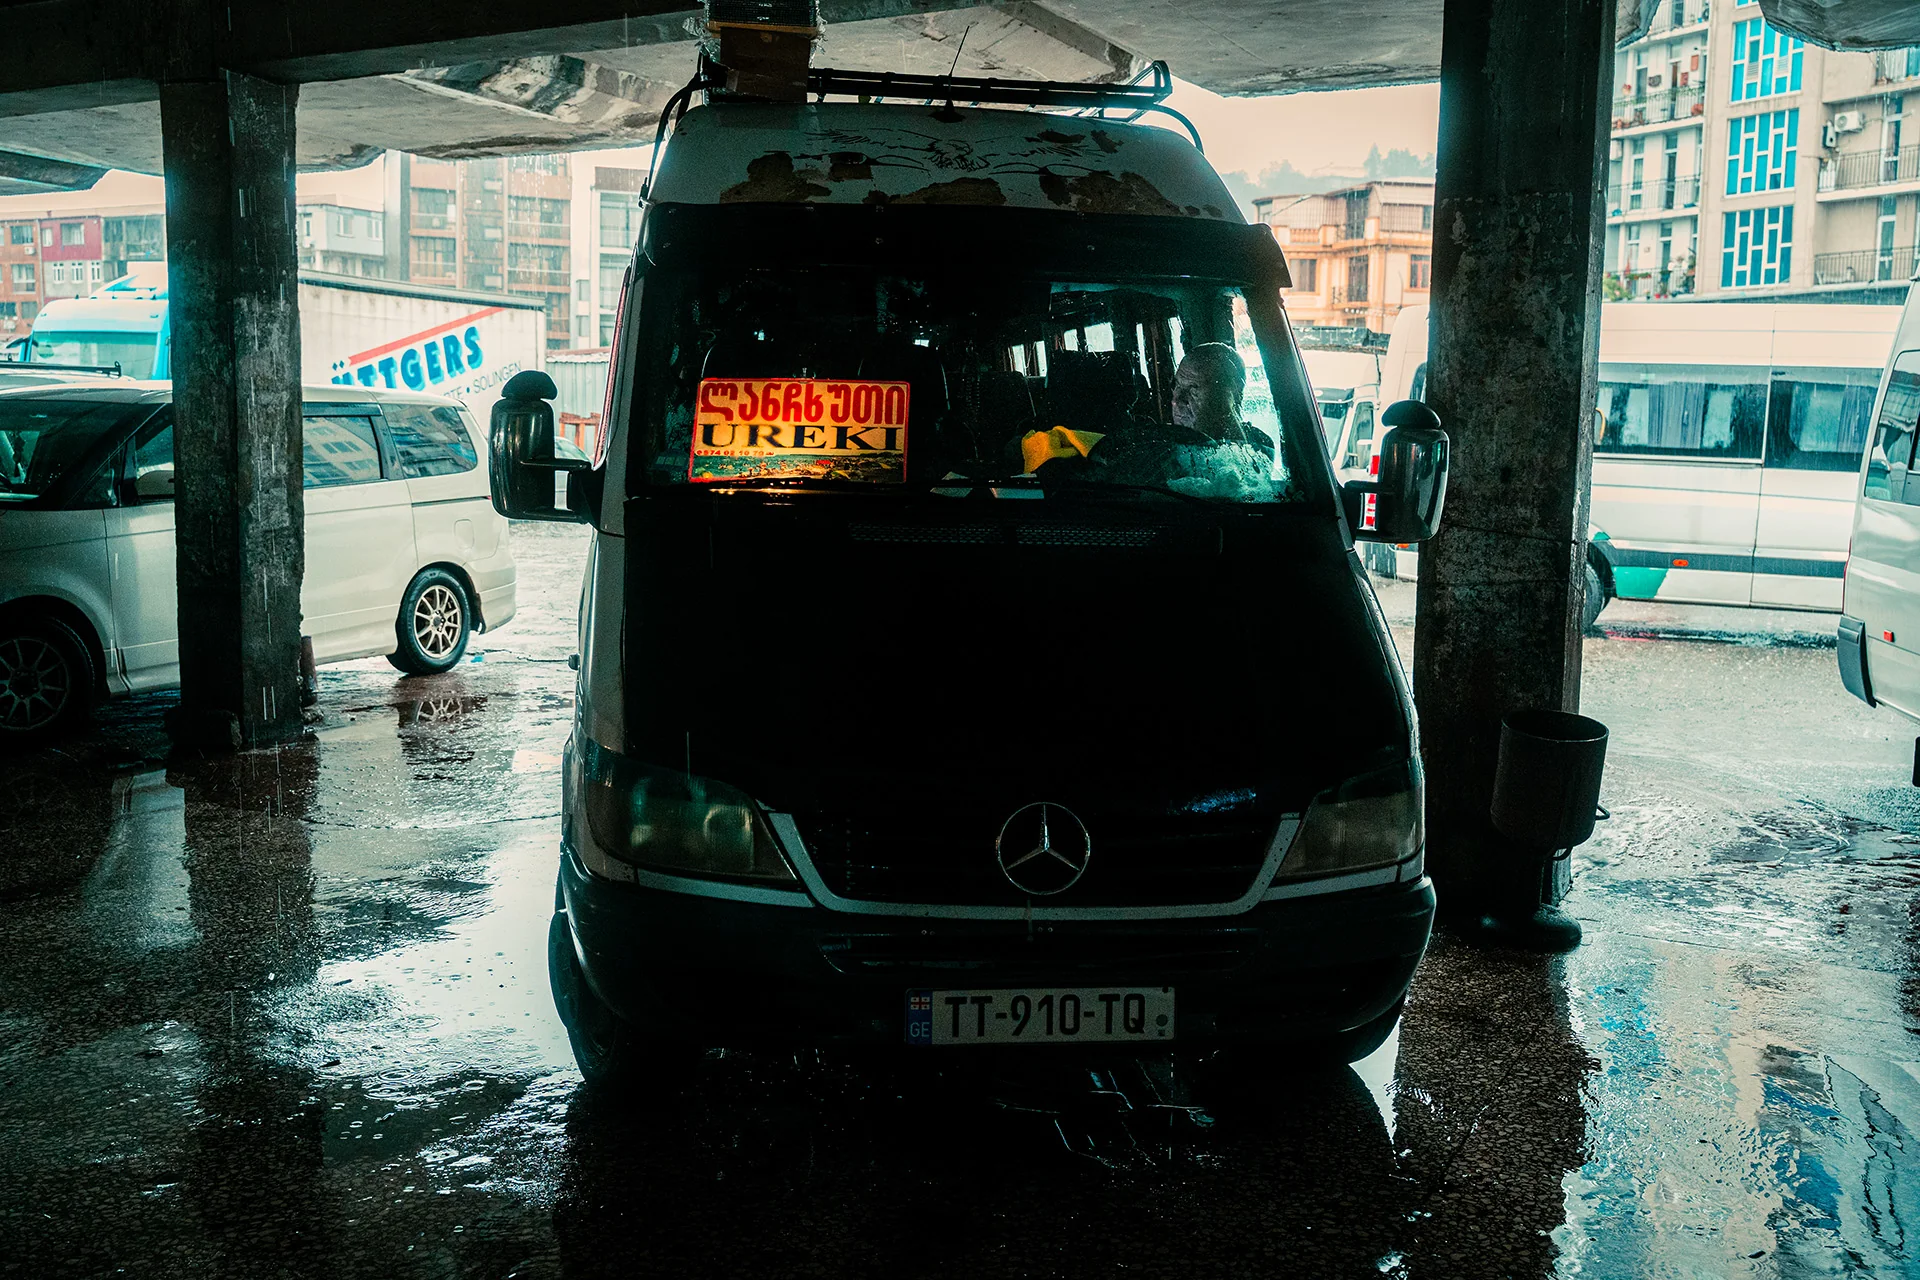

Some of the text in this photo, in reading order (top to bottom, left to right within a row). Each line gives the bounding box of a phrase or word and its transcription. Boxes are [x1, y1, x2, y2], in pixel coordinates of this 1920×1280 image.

[473, 360, 522, 394] SOLINGEN
[700, 382, 905, 425] ლანჩხუთი
[699, 423, 903, 451] UREKI
[910, 1021, 930, 1038] GE
[945, 994, 1145, 1037] TT-910-TQ
